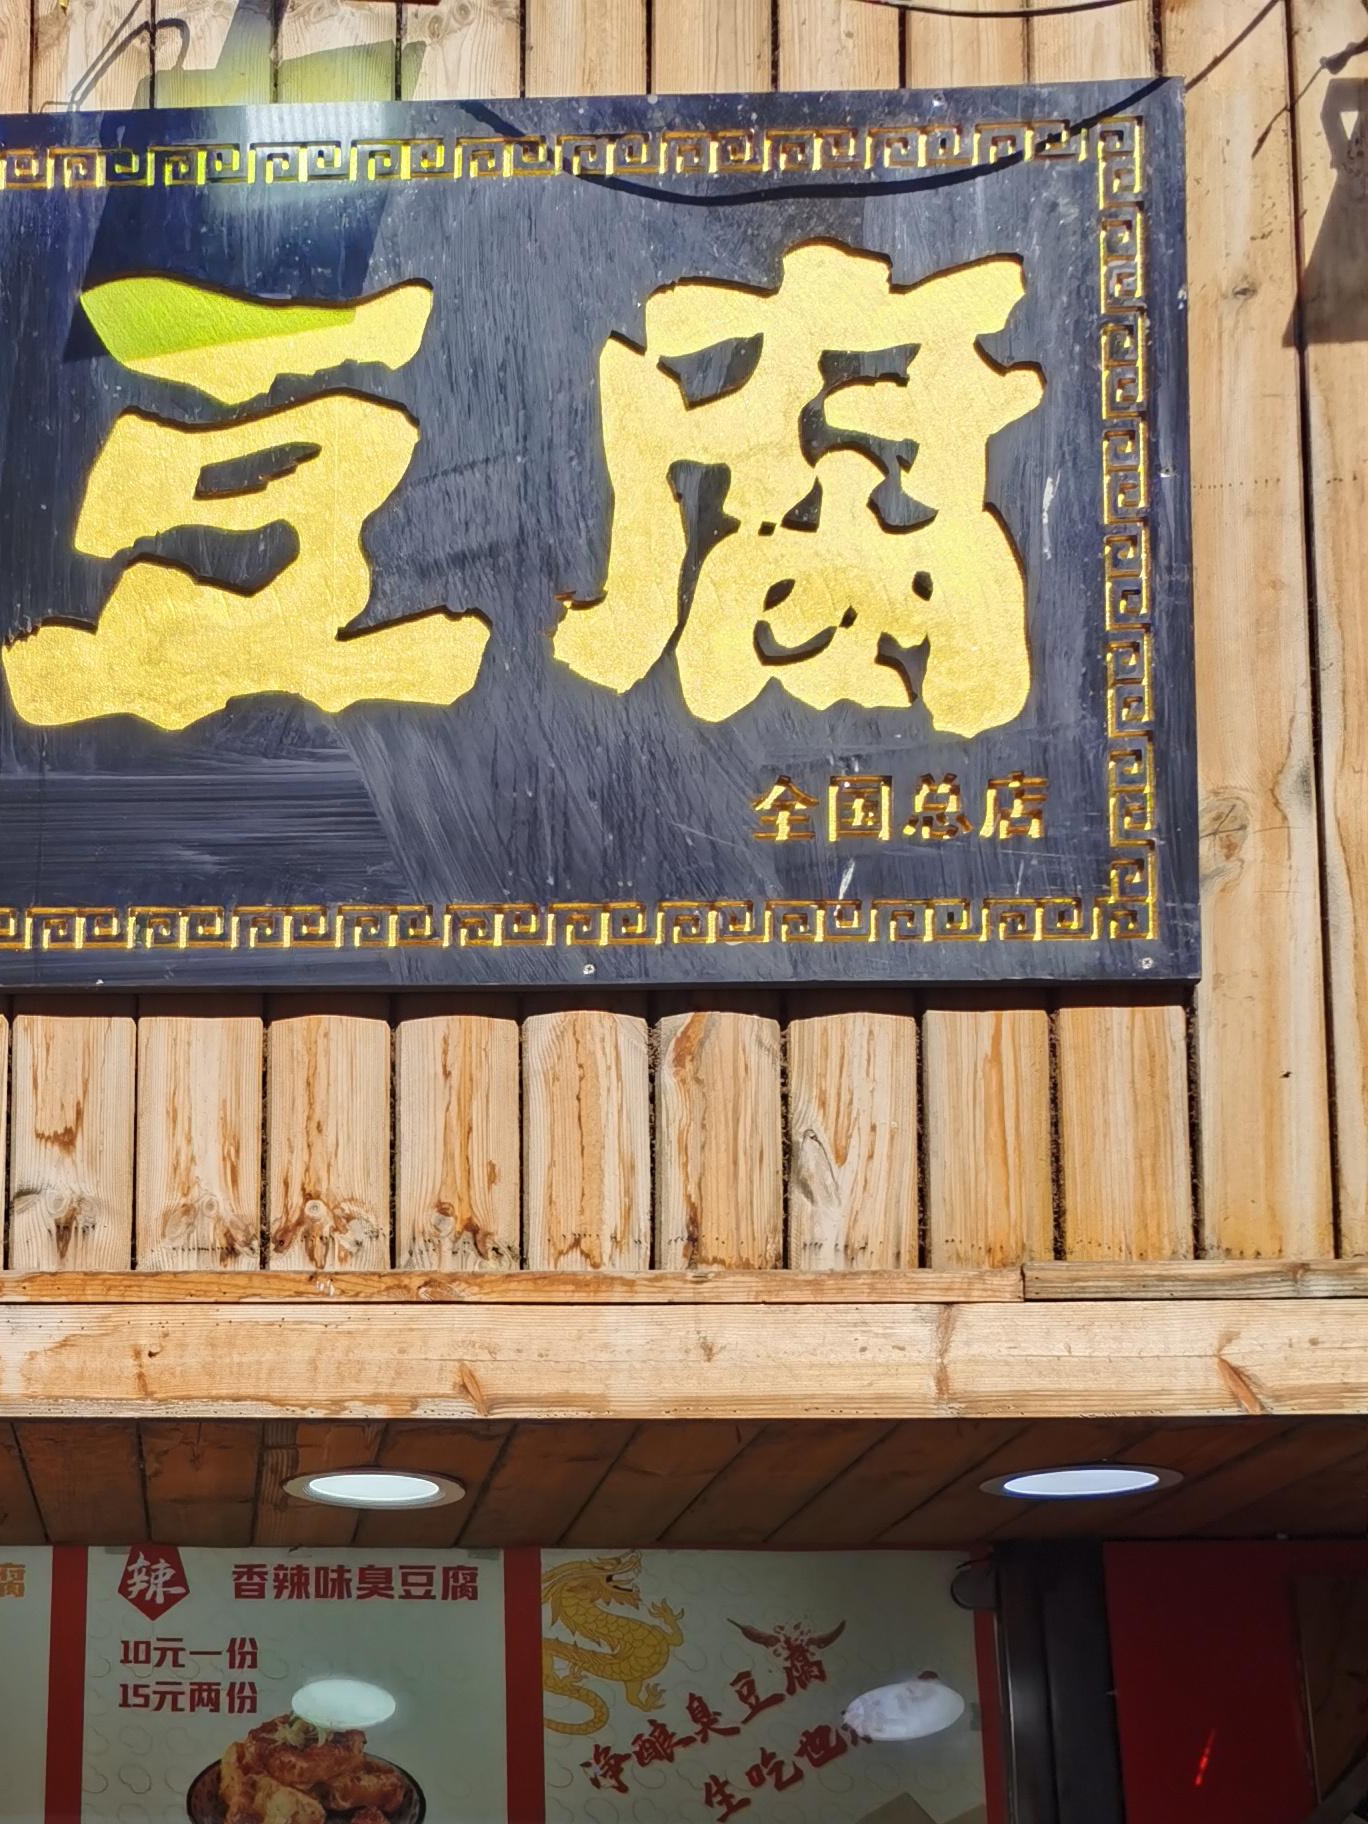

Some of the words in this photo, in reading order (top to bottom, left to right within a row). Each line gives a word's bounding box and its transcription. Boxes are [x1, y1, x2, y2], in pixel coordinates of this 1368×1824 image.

[752, 772, 1050, 842] 全国总店
[125, 1552, 188, 1604] 辣
[232, 1563, 480, 1601] 香辣味臭豆腐
[119, 1636, 259, 1670] 10元一份
[118, 1680, 258, 1714] 15元两份
